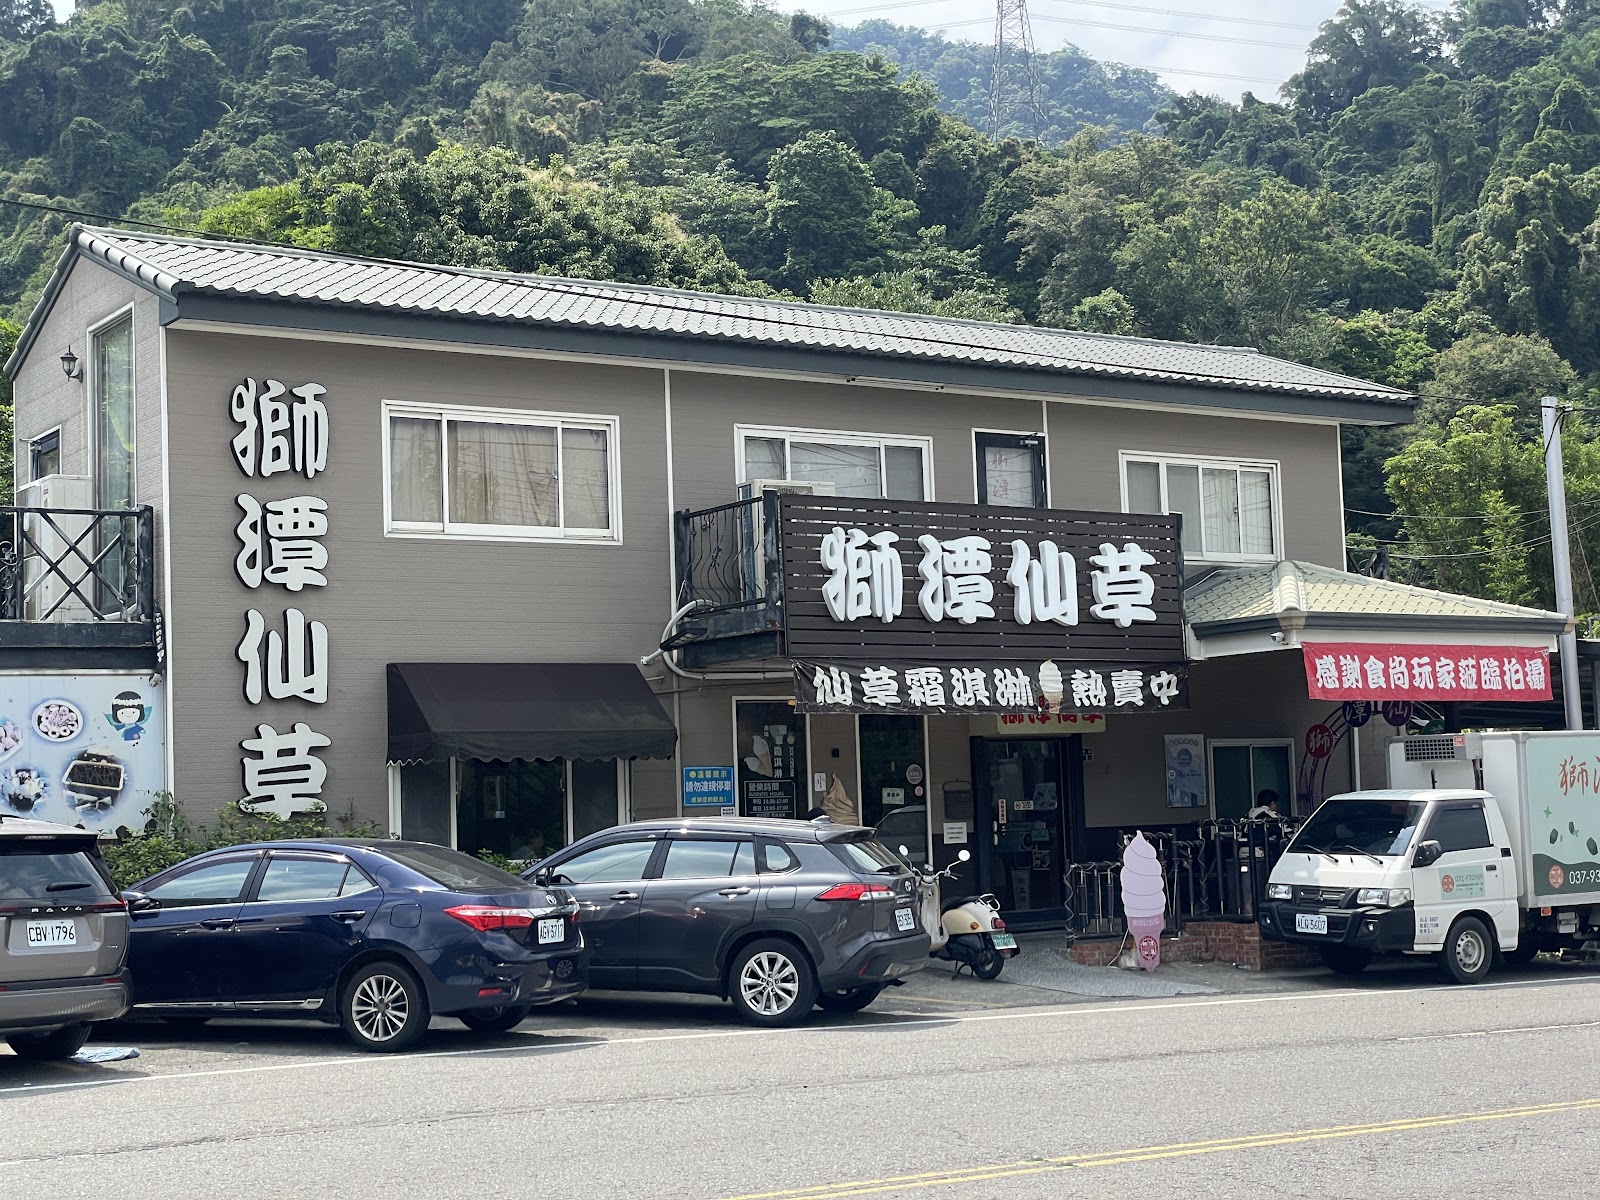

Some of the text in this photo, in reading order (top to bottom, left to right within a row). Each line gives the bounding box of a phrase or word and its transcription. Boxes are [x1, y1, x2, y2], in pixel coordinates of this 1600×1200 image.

[820, 526, 1157, 628] 獅潭仙草
[229, 377, 333, 820] 獅潭仙草
[813, 665, 1180, 708] 仙草霜淇淋 熱賣中
[1315, 654, 1546, 690] 感謝食尚玩家蒞臨拍攝
[685, 780, 732, 793] 請勿違規停車
[31, 905, 82, 913] RAV4
[28, 925, 75, 942] CBV-1796
